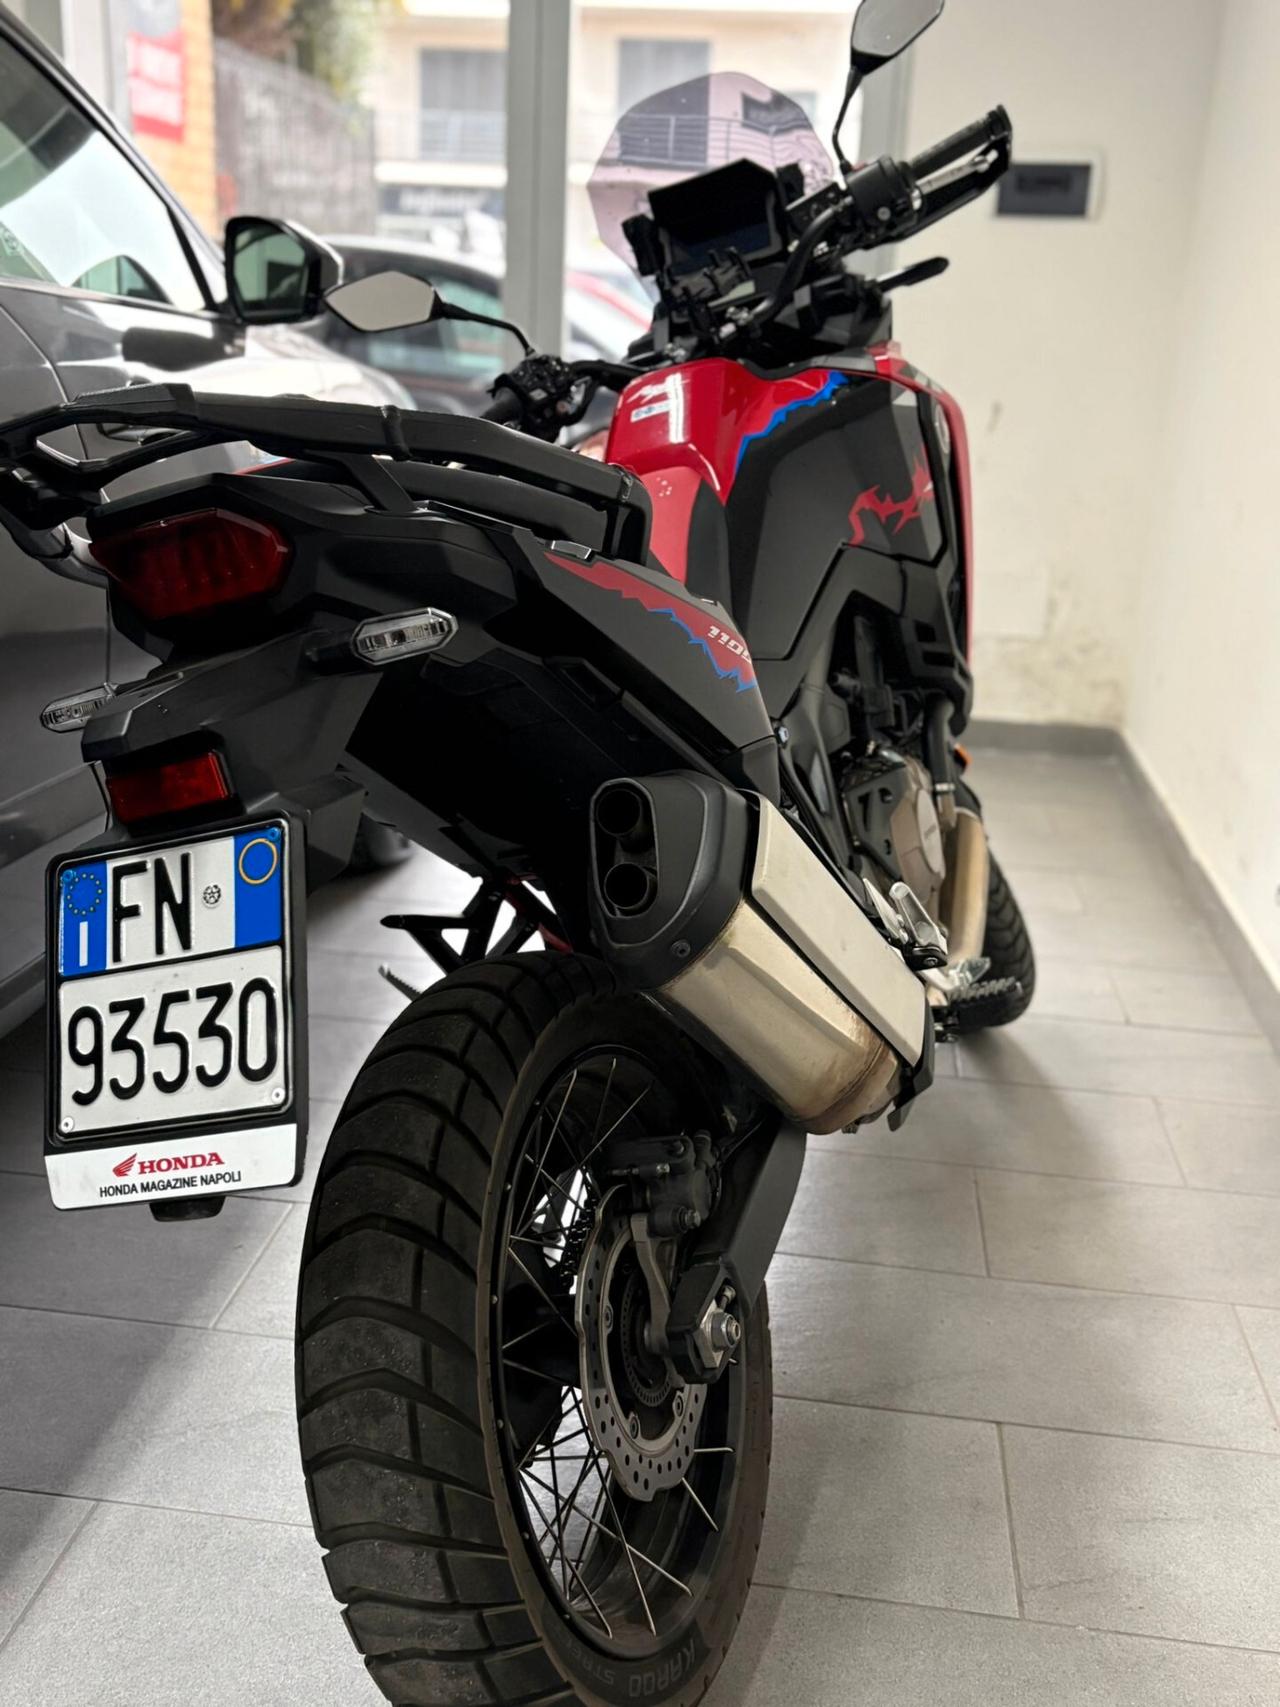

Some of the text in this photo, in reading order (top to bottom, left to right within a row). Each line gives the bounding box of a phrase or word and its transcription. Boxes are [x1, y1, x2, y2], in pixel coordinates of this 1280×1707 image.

[112, 852, 192, 963] FN
[67, 976, 278, 1106] 93530
[99, 1170, 242, 1198] HONDA MAGAZINE NAPOLI
[138, 1152, 225, 1175] HONDA
[628, 1639, 696, 1697] KAROO
